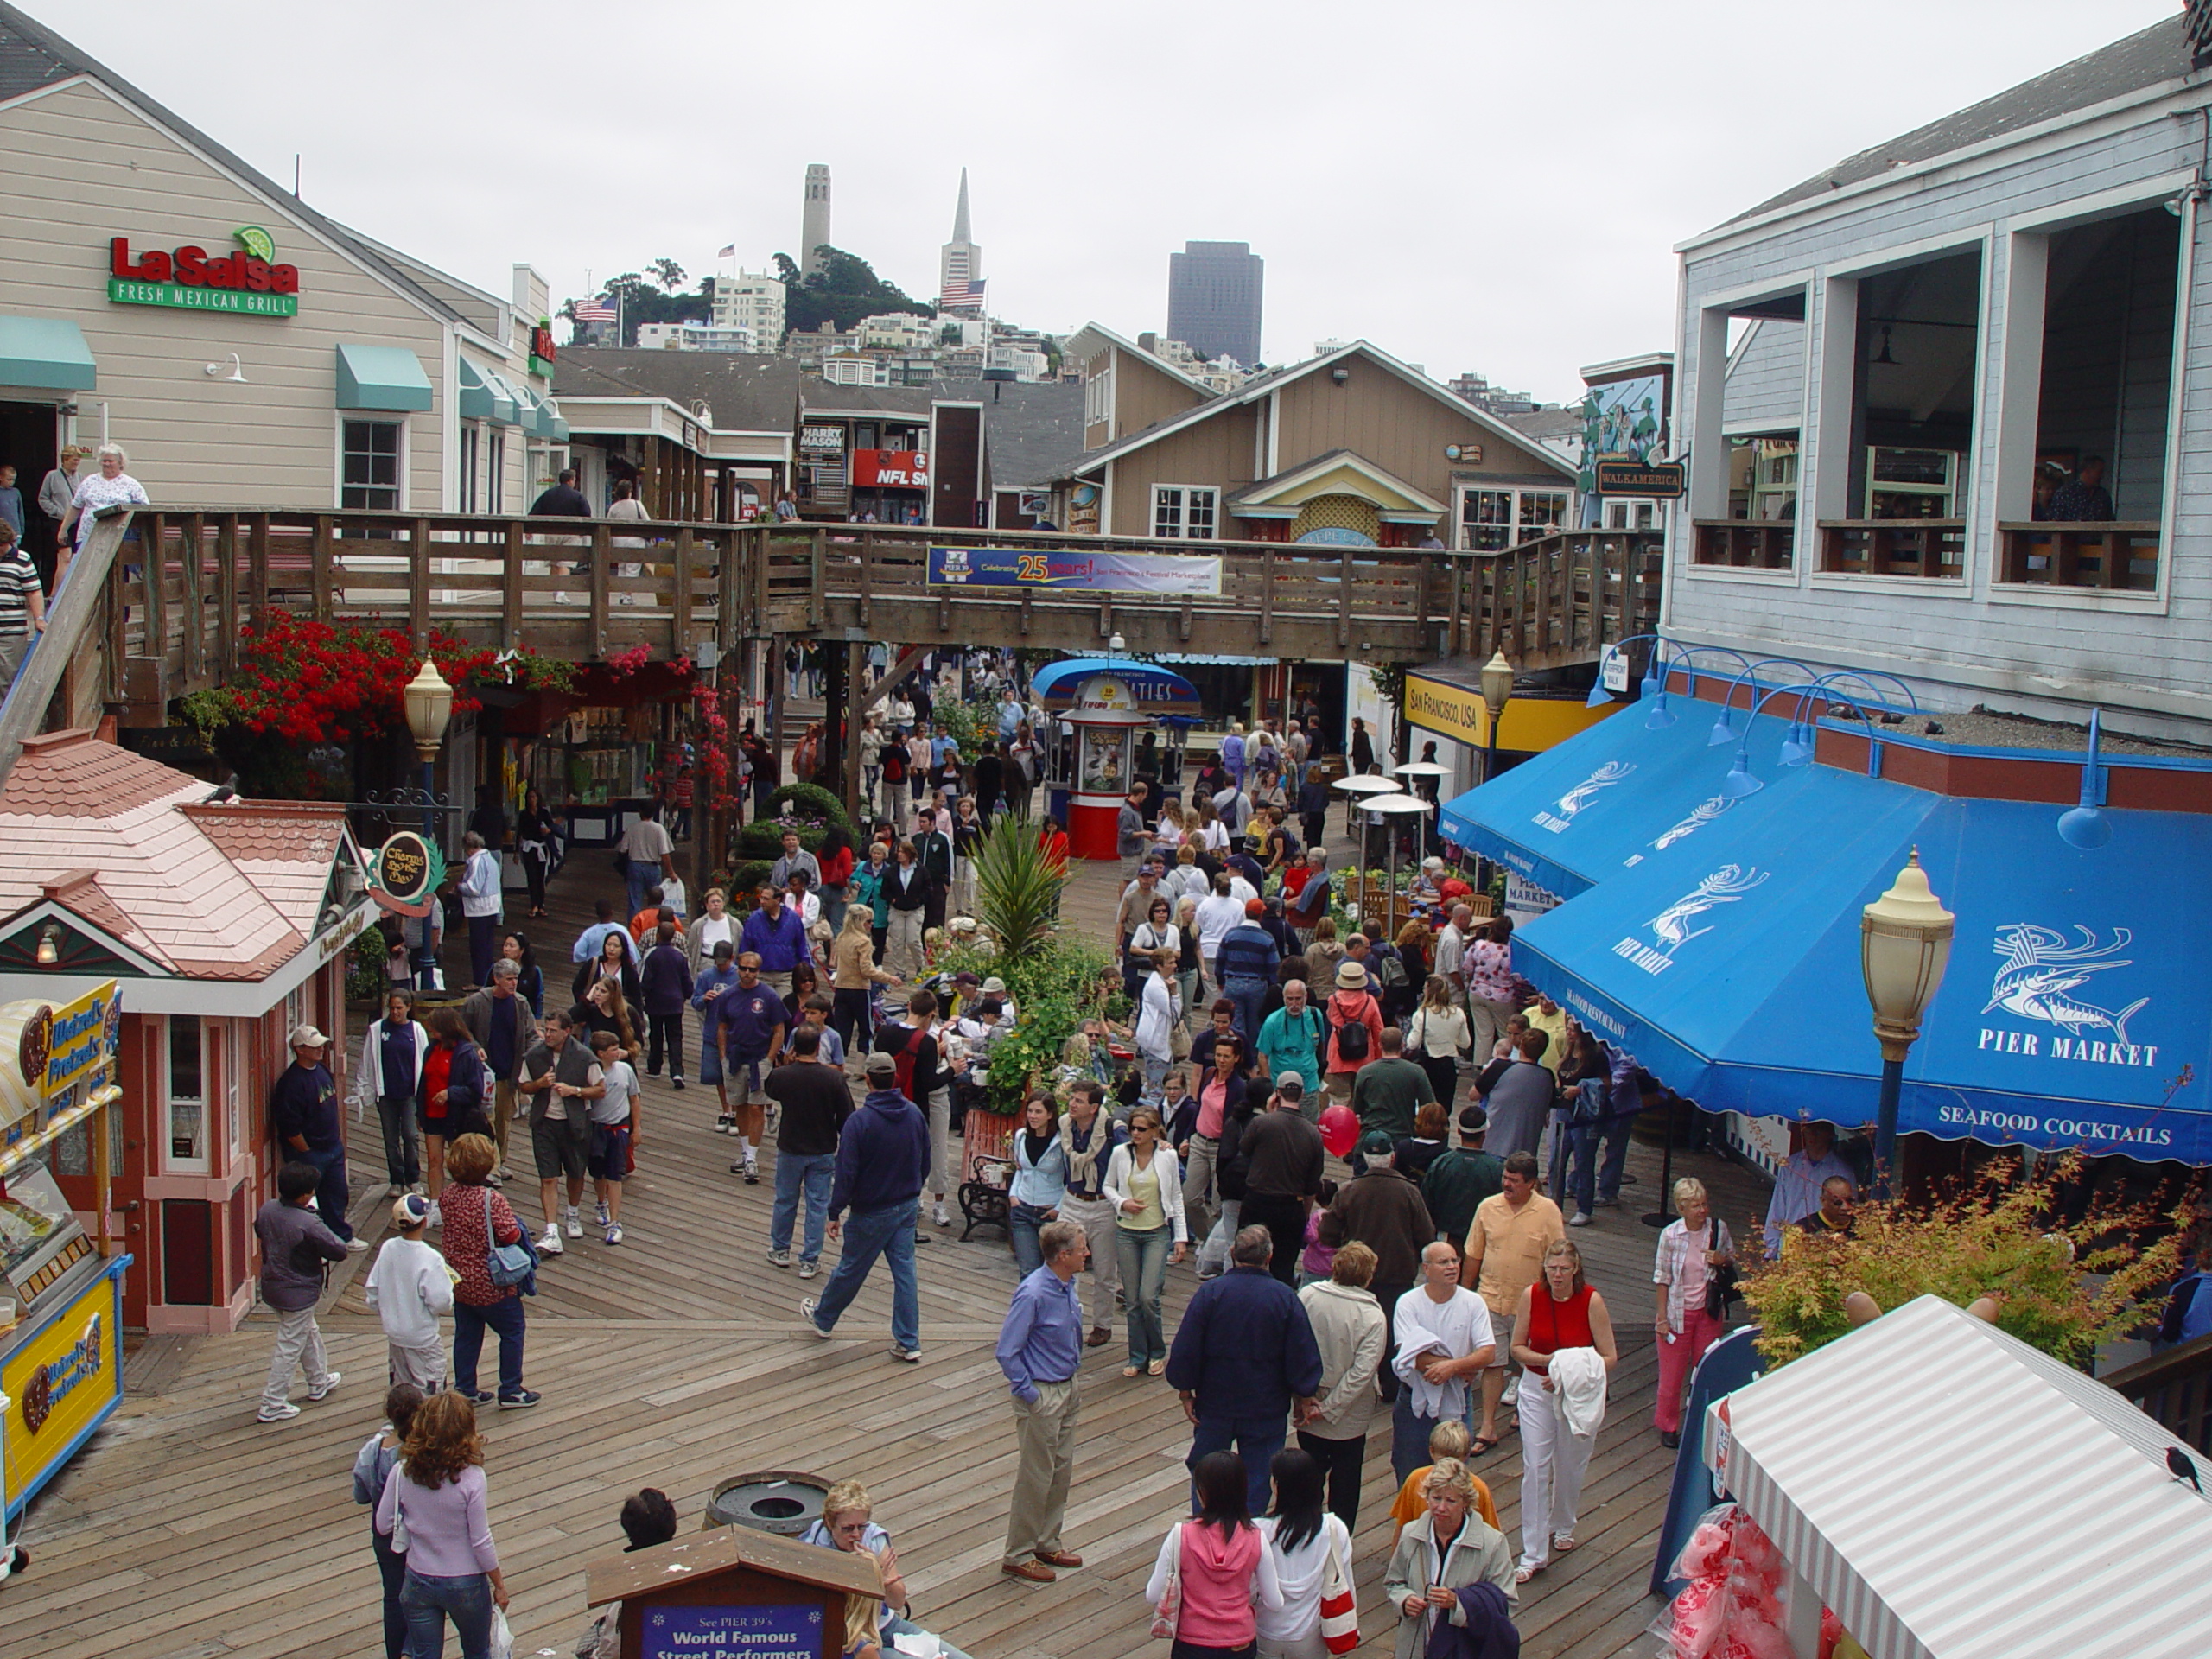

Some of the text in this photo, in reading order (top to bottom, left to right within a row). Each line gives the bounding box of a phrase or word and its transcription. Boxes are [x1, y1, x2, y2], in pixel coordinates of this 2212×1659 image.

[118, 284, 164, 302] FRESH
[174, 289, 238, 308] MEXICAN
[802, 427, 842, 438] HARRY
[800, 436, 842, 447] MASON
[877, 469, 909, 485] NFL
[1602, 473, 1678, 486] WALKAMERICA
[1306, 531, 1339, 544] REPE
[1018, 555, 1048, 581] 25
[1047, 560, 1093, 582] years!
[1171, 571, 1211, 580] Marketplace
[1410, 688, 1423, 712] SAN
[1460, 702, 1477, 732] USA
[1509, 887, 1553, 906] MARKET
[1587, 1003, 1626, 1039] RESTAURANT
[1978, 1028, 2158, 1067] PIER MARKET
[1938, 1105, 2171, 1146] SEAFOOD COCKTAILS
[699, 1617, 772, 1627] See PIER 39's
[673, 1630, 797, 1644] World Famous
[658, 1649, 811, 1659] Street Performers
